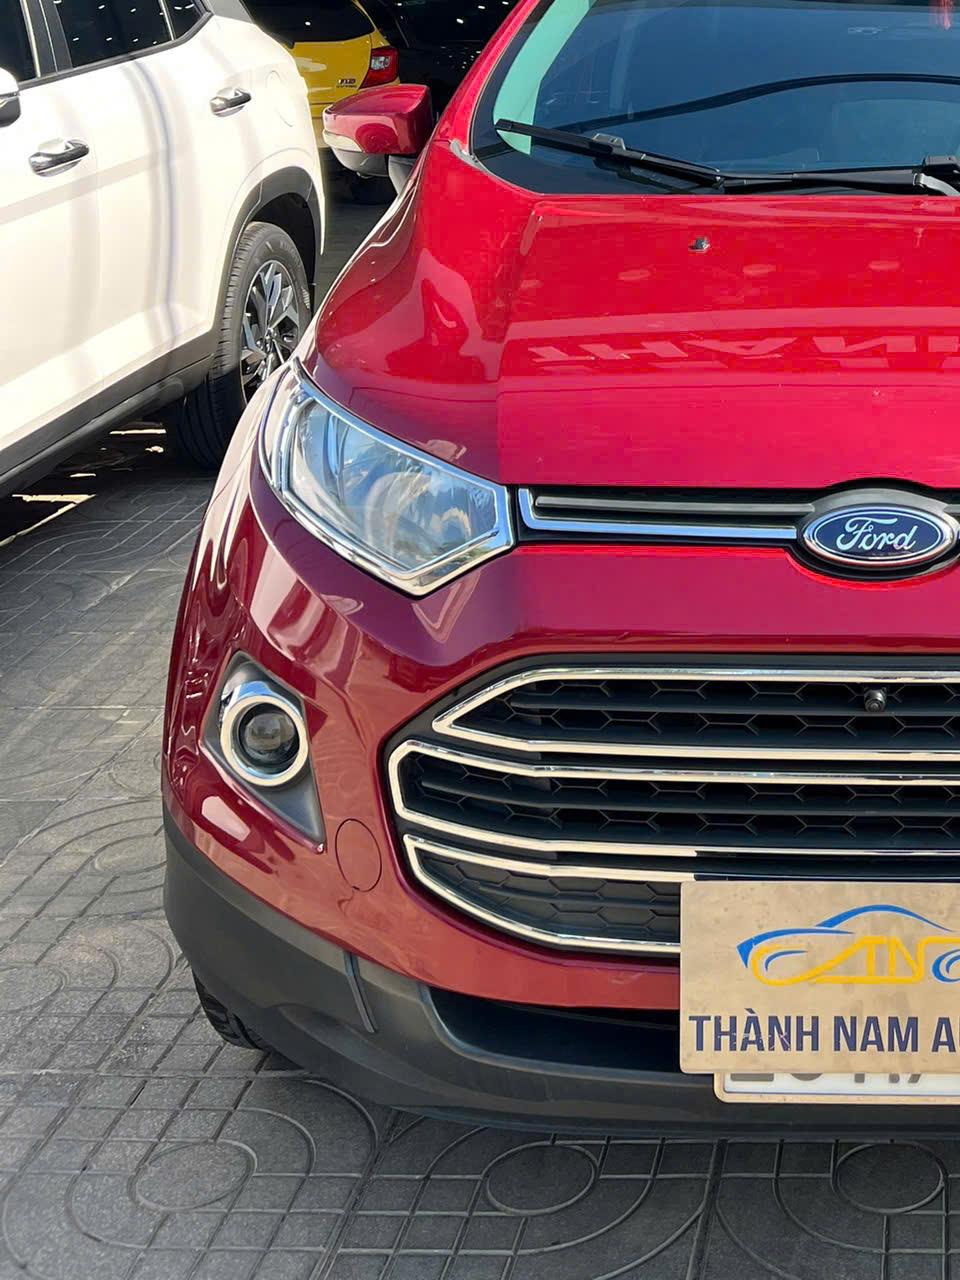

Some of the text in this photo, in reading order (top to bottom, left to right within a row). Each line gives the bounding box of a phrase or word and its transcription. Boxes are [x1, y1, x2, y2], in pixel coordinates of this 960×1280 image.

[836, 516, 918, 551] Ford
[688, 1007, 820, 1052] THÀNH
[833, 1015, 919, 1053] NAM
